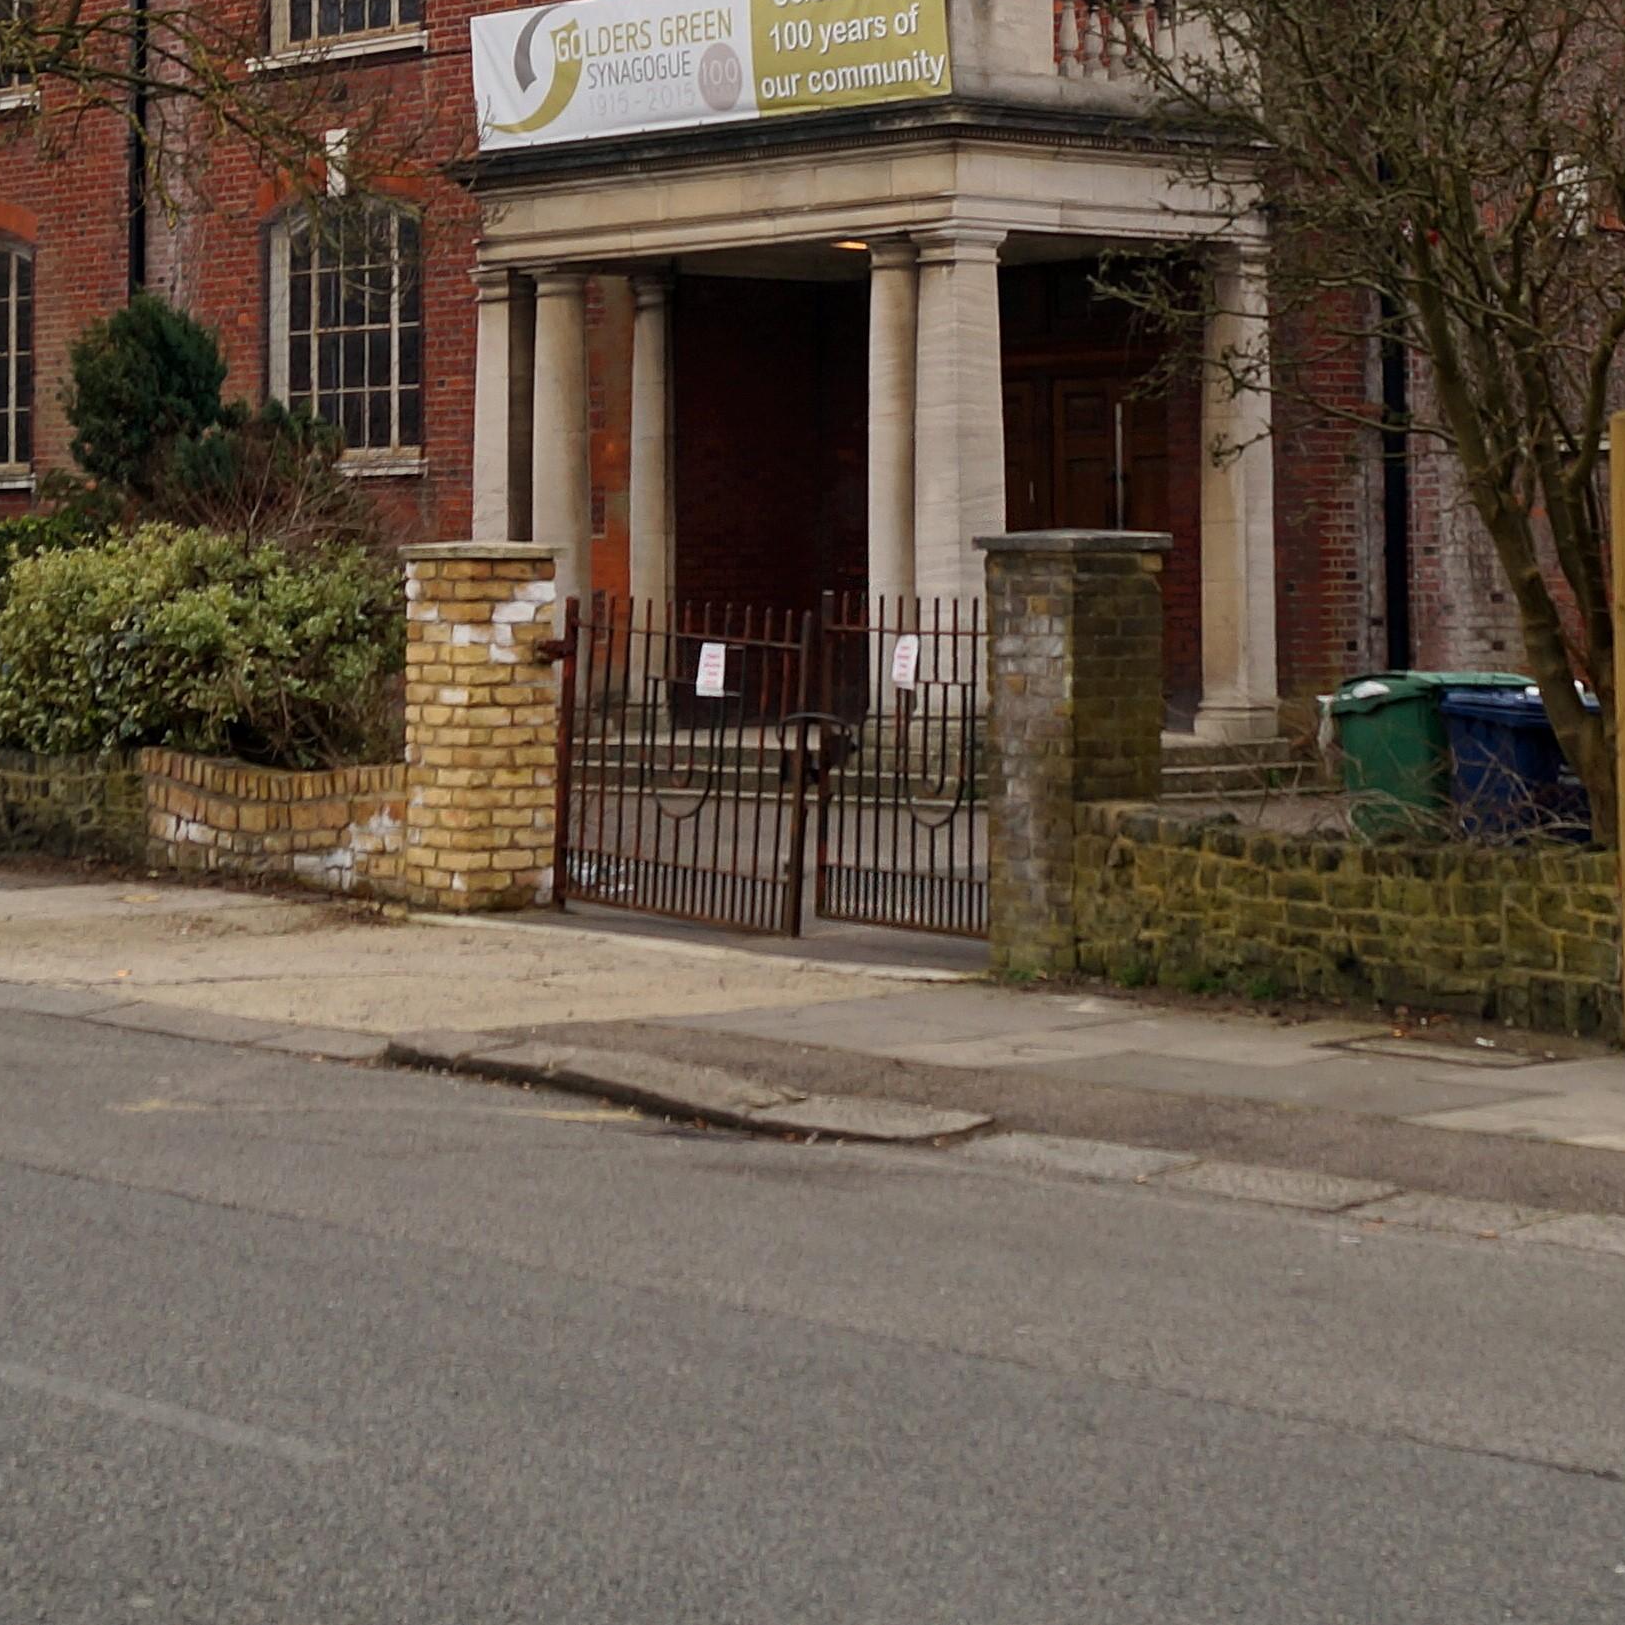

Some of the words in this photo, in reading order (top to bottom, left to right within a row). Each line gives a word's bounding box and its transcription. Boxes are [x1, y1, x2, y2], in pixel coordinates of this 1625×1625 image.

[555, 19, 652, 63] GOLDERS
[660, 7, 732, 48] GREEN
[769, 19, 813, 54] 100
[819, 14, 887, 55] years
[894, 2, 920, 37] of
[586, 49, 692, 90] SYNAGOGUE
[702, 57, 738, 86] 100
[761, 73, 802, 99] our
[808, 49, 945, 95] community
[588, 89, 630, 117] 1915
[647, 81, 696, 112] 2015
